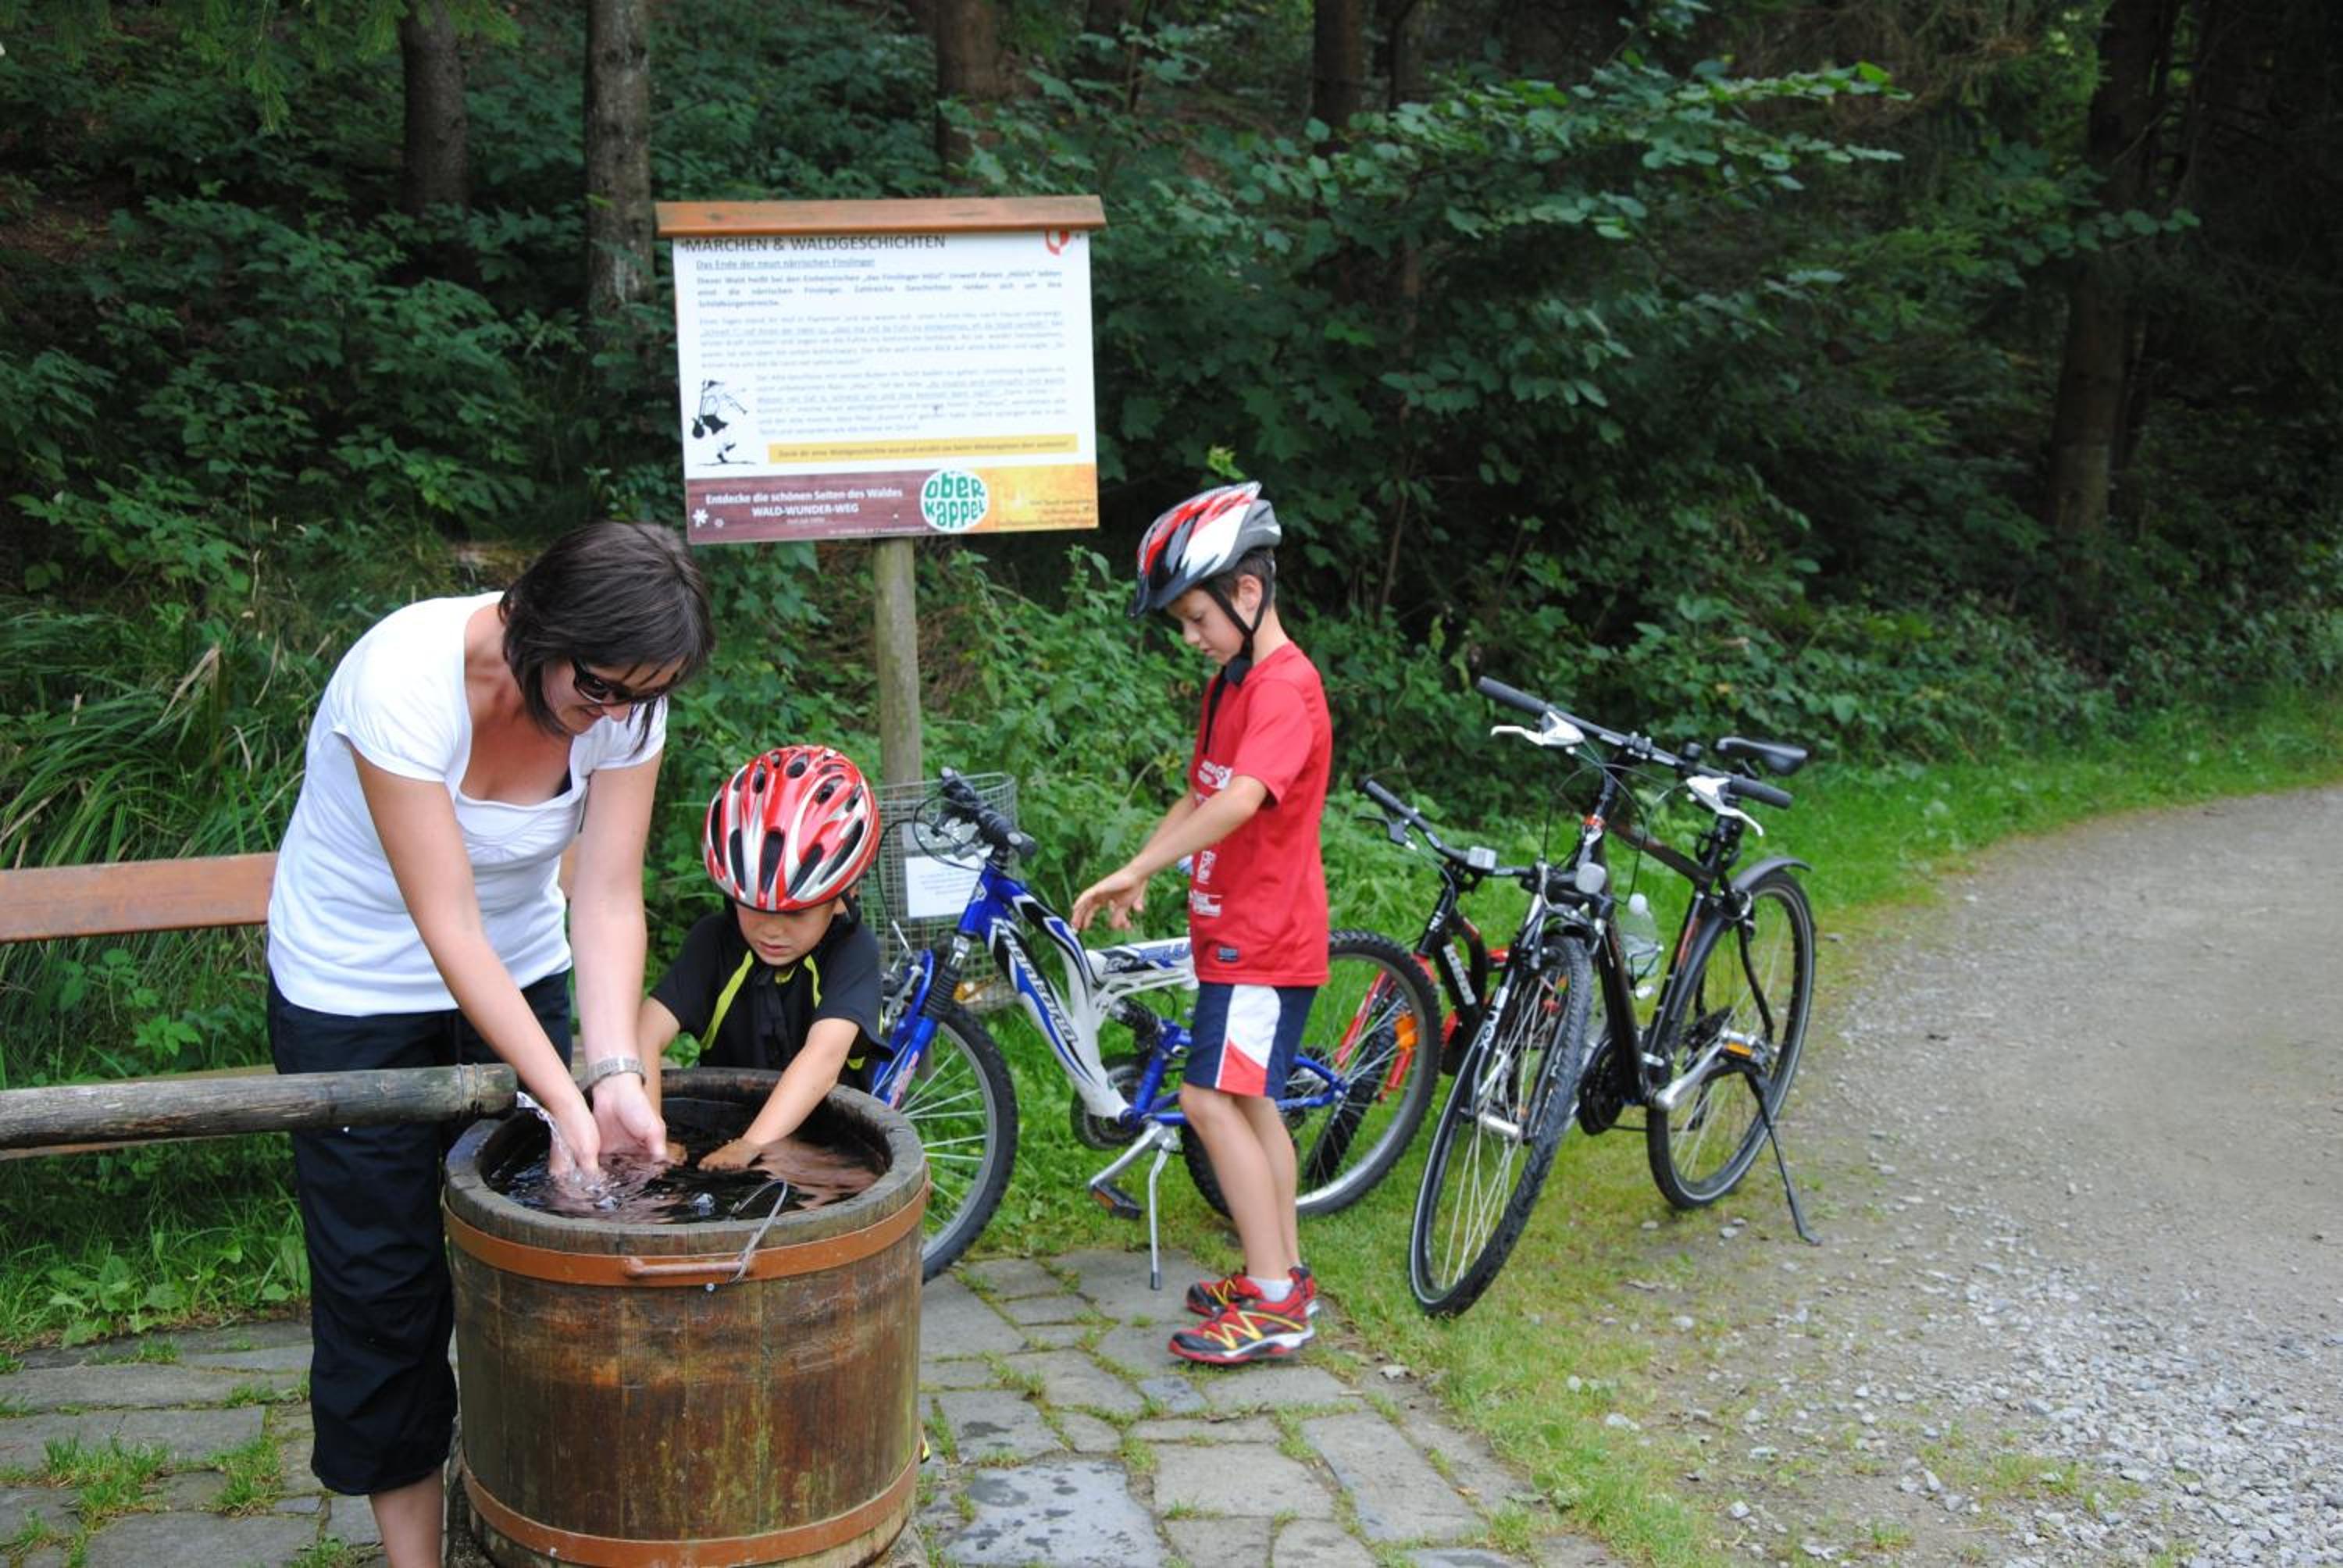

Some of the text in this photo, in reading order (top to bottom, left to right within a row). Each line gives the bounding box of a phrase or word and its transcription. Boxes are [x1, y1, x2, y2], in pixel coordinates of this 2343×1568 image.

[773, 236, 785, 251] &
[790, 235, 946, 251] WALDGESCHICHTEN
[706, 487, 902, 504] Entdecke die schönen Seiten des Waldes
[751, 503, 859, 517] WALD-WUNDER-WEG
